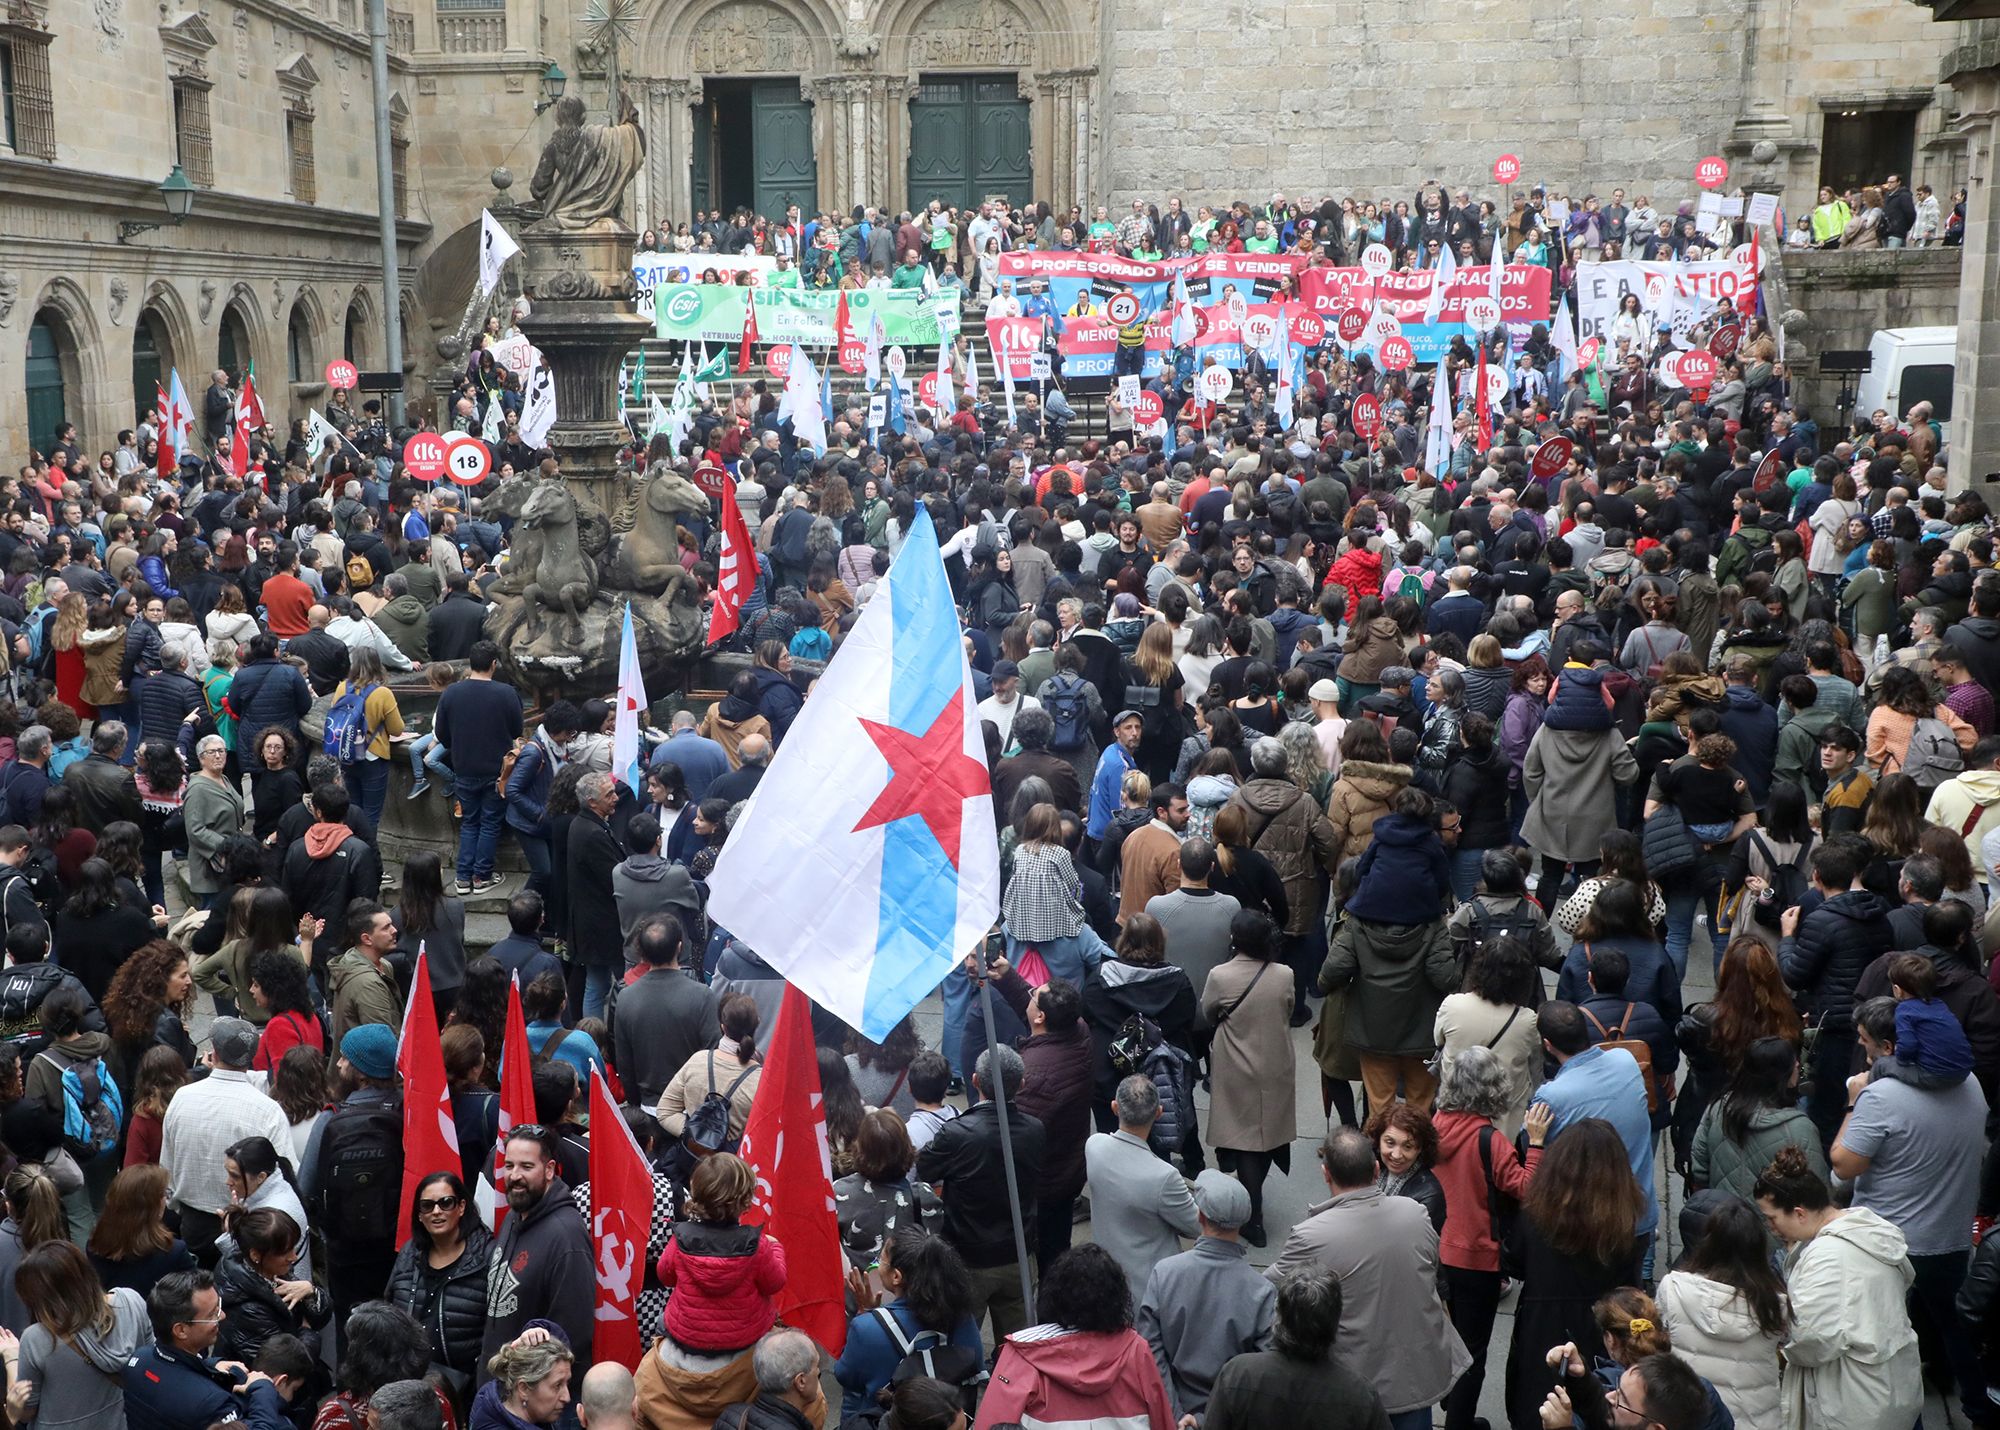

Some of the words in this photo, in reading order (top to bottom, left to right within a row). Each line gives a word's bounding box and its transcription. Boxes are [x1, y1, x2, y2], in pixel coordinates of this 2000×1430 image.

[1701, 164, 1722, 176] CIG
[1369, 251, 1386, 264] CIG
[1012, 259, 1025, 270] O
[1031, 259, 1157, 277] PROFESORADO
[1205, 260, 1228, 271] SE
[1235, 262, 1292, 274] VENDE
[1324, 271, 1374, 287] POLA
[1186, 282, 1208, 291] ATIOS
[1593, 279, 1607, 299] E
[1617, 278, 1631, 297] A
[674, 300, 700, 313] CSIF
[1116, 305, 1130, 314] 21
[1474, 305, 1494, 317] CIG
[1250, 321, 1271, 335] CIG
[1299, 317, 1320, 334] CIG
[1344, 315, 1361, 328] CIG
[1582, 317, 1605, 338] DE
[773, 334, 802, 343] HORAS
[1000, 324, 1041, 350] CIG
[1077, 329, 1119, 342] MENO
[845, 349, 864, 361] CIG
[1387, 343, 1406, 358] CIG
[1684, 358, 1709, 373] CIG
[332, 367, 352, 378] CIG
[1207, 374, 1226, 386] CIG
[1358, 403, 1376, 420] CIG
[413, 443, 442, 461] CIG
[457, 456, 478, 469] 18
